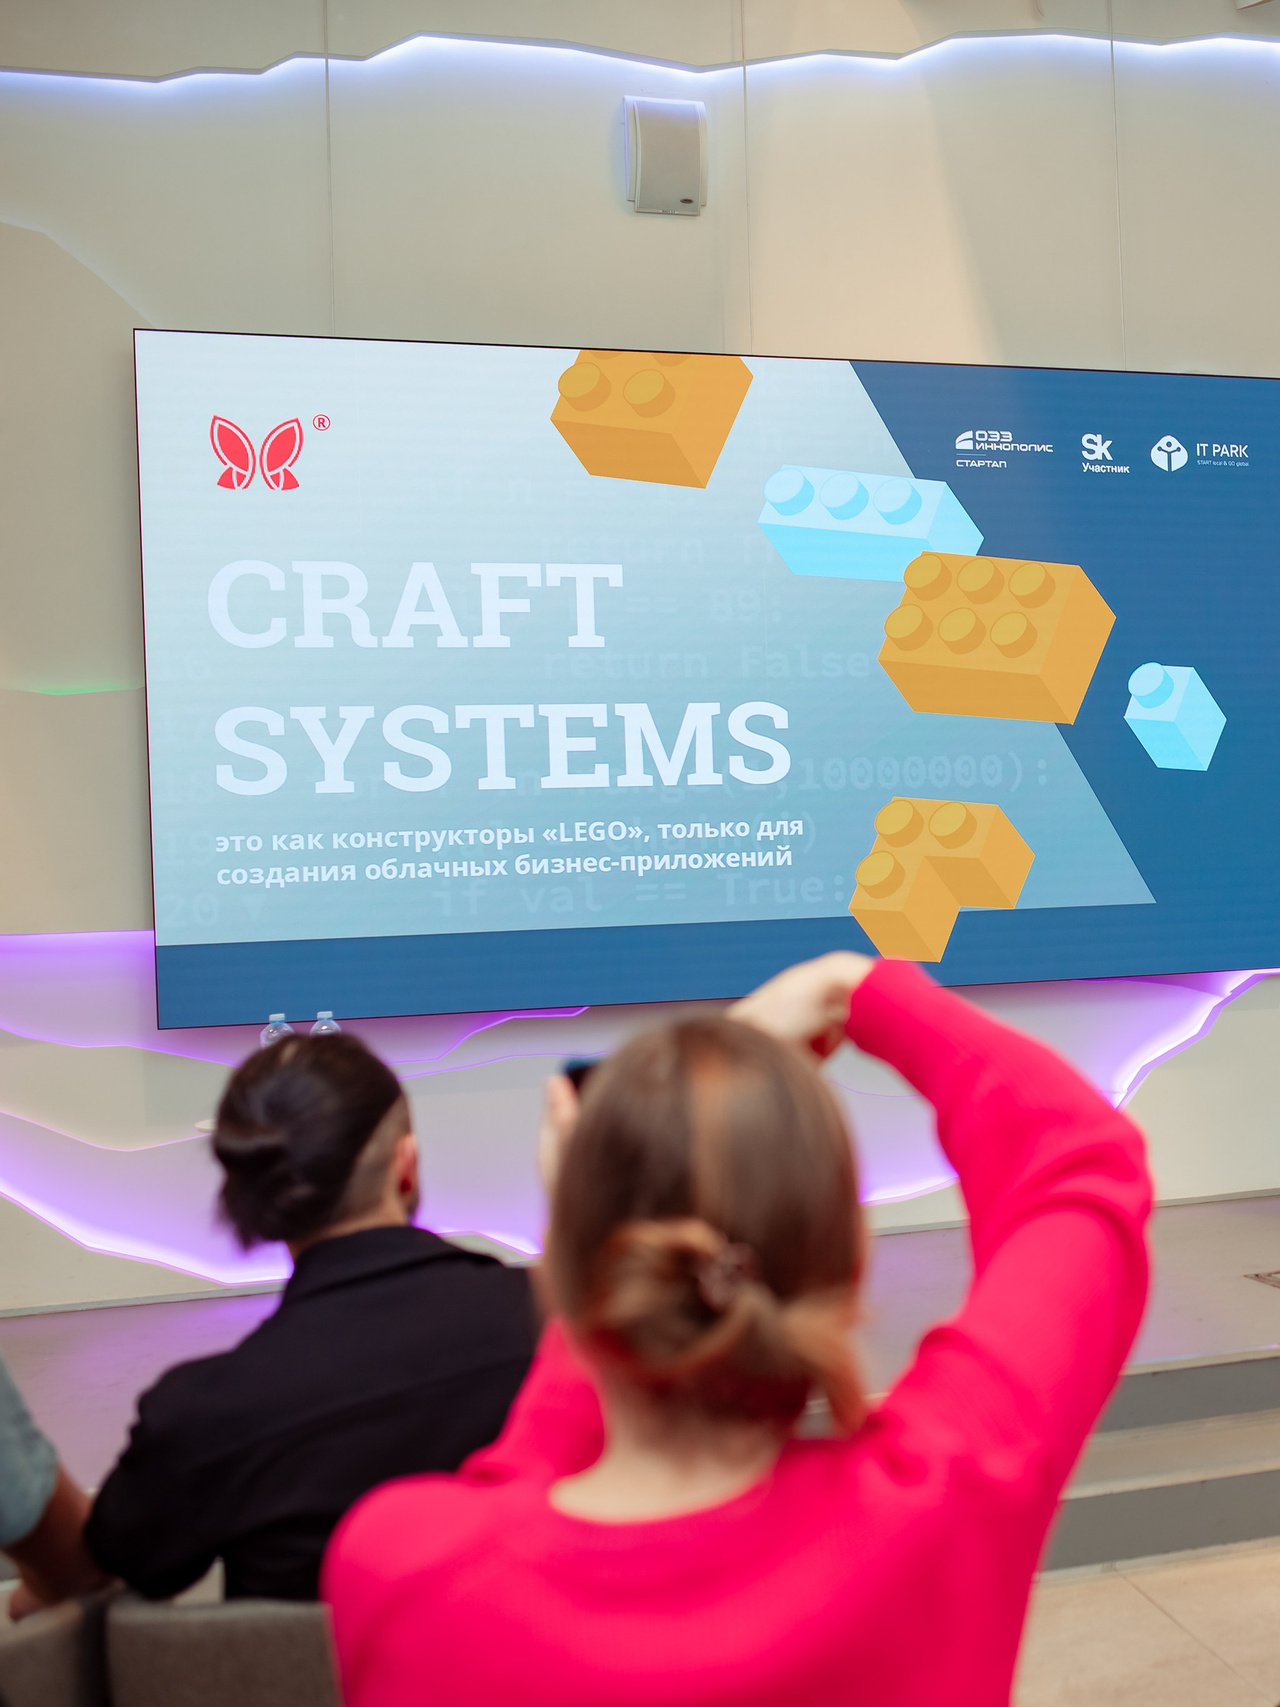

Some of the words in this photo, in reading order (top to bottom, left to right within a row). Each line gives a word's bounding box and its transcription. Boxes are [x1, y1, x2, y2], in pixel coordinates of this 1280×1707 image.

[975, 430, 1013, 442] ОЭЗ
[1081, 433, 1113, 461] Sk
[956, 459, 1007, 468] СТАРТАП
[1196, 443, 1209, 457] IT
[1212, 443, 1249, 458] PARK
[1082, 462, 1130, 473] Участник
[207, 559, 624, 649] CRAFT
[214, 700, 792, 796] SYSTEMS
[215, 834, 263, 852] это
[272, 833, 325, 851] как
[332, 827, 535, 853] конструкторы
[542, 821, 651, 843] «LEGO»,
[657, 820, 751, 840] только
[756, 820, 804, 842] для
[216, 864, 357, 889] создания
[365, 857, 509, 881] облачных
[514, 845, 793, 877] бизнес-приложений
